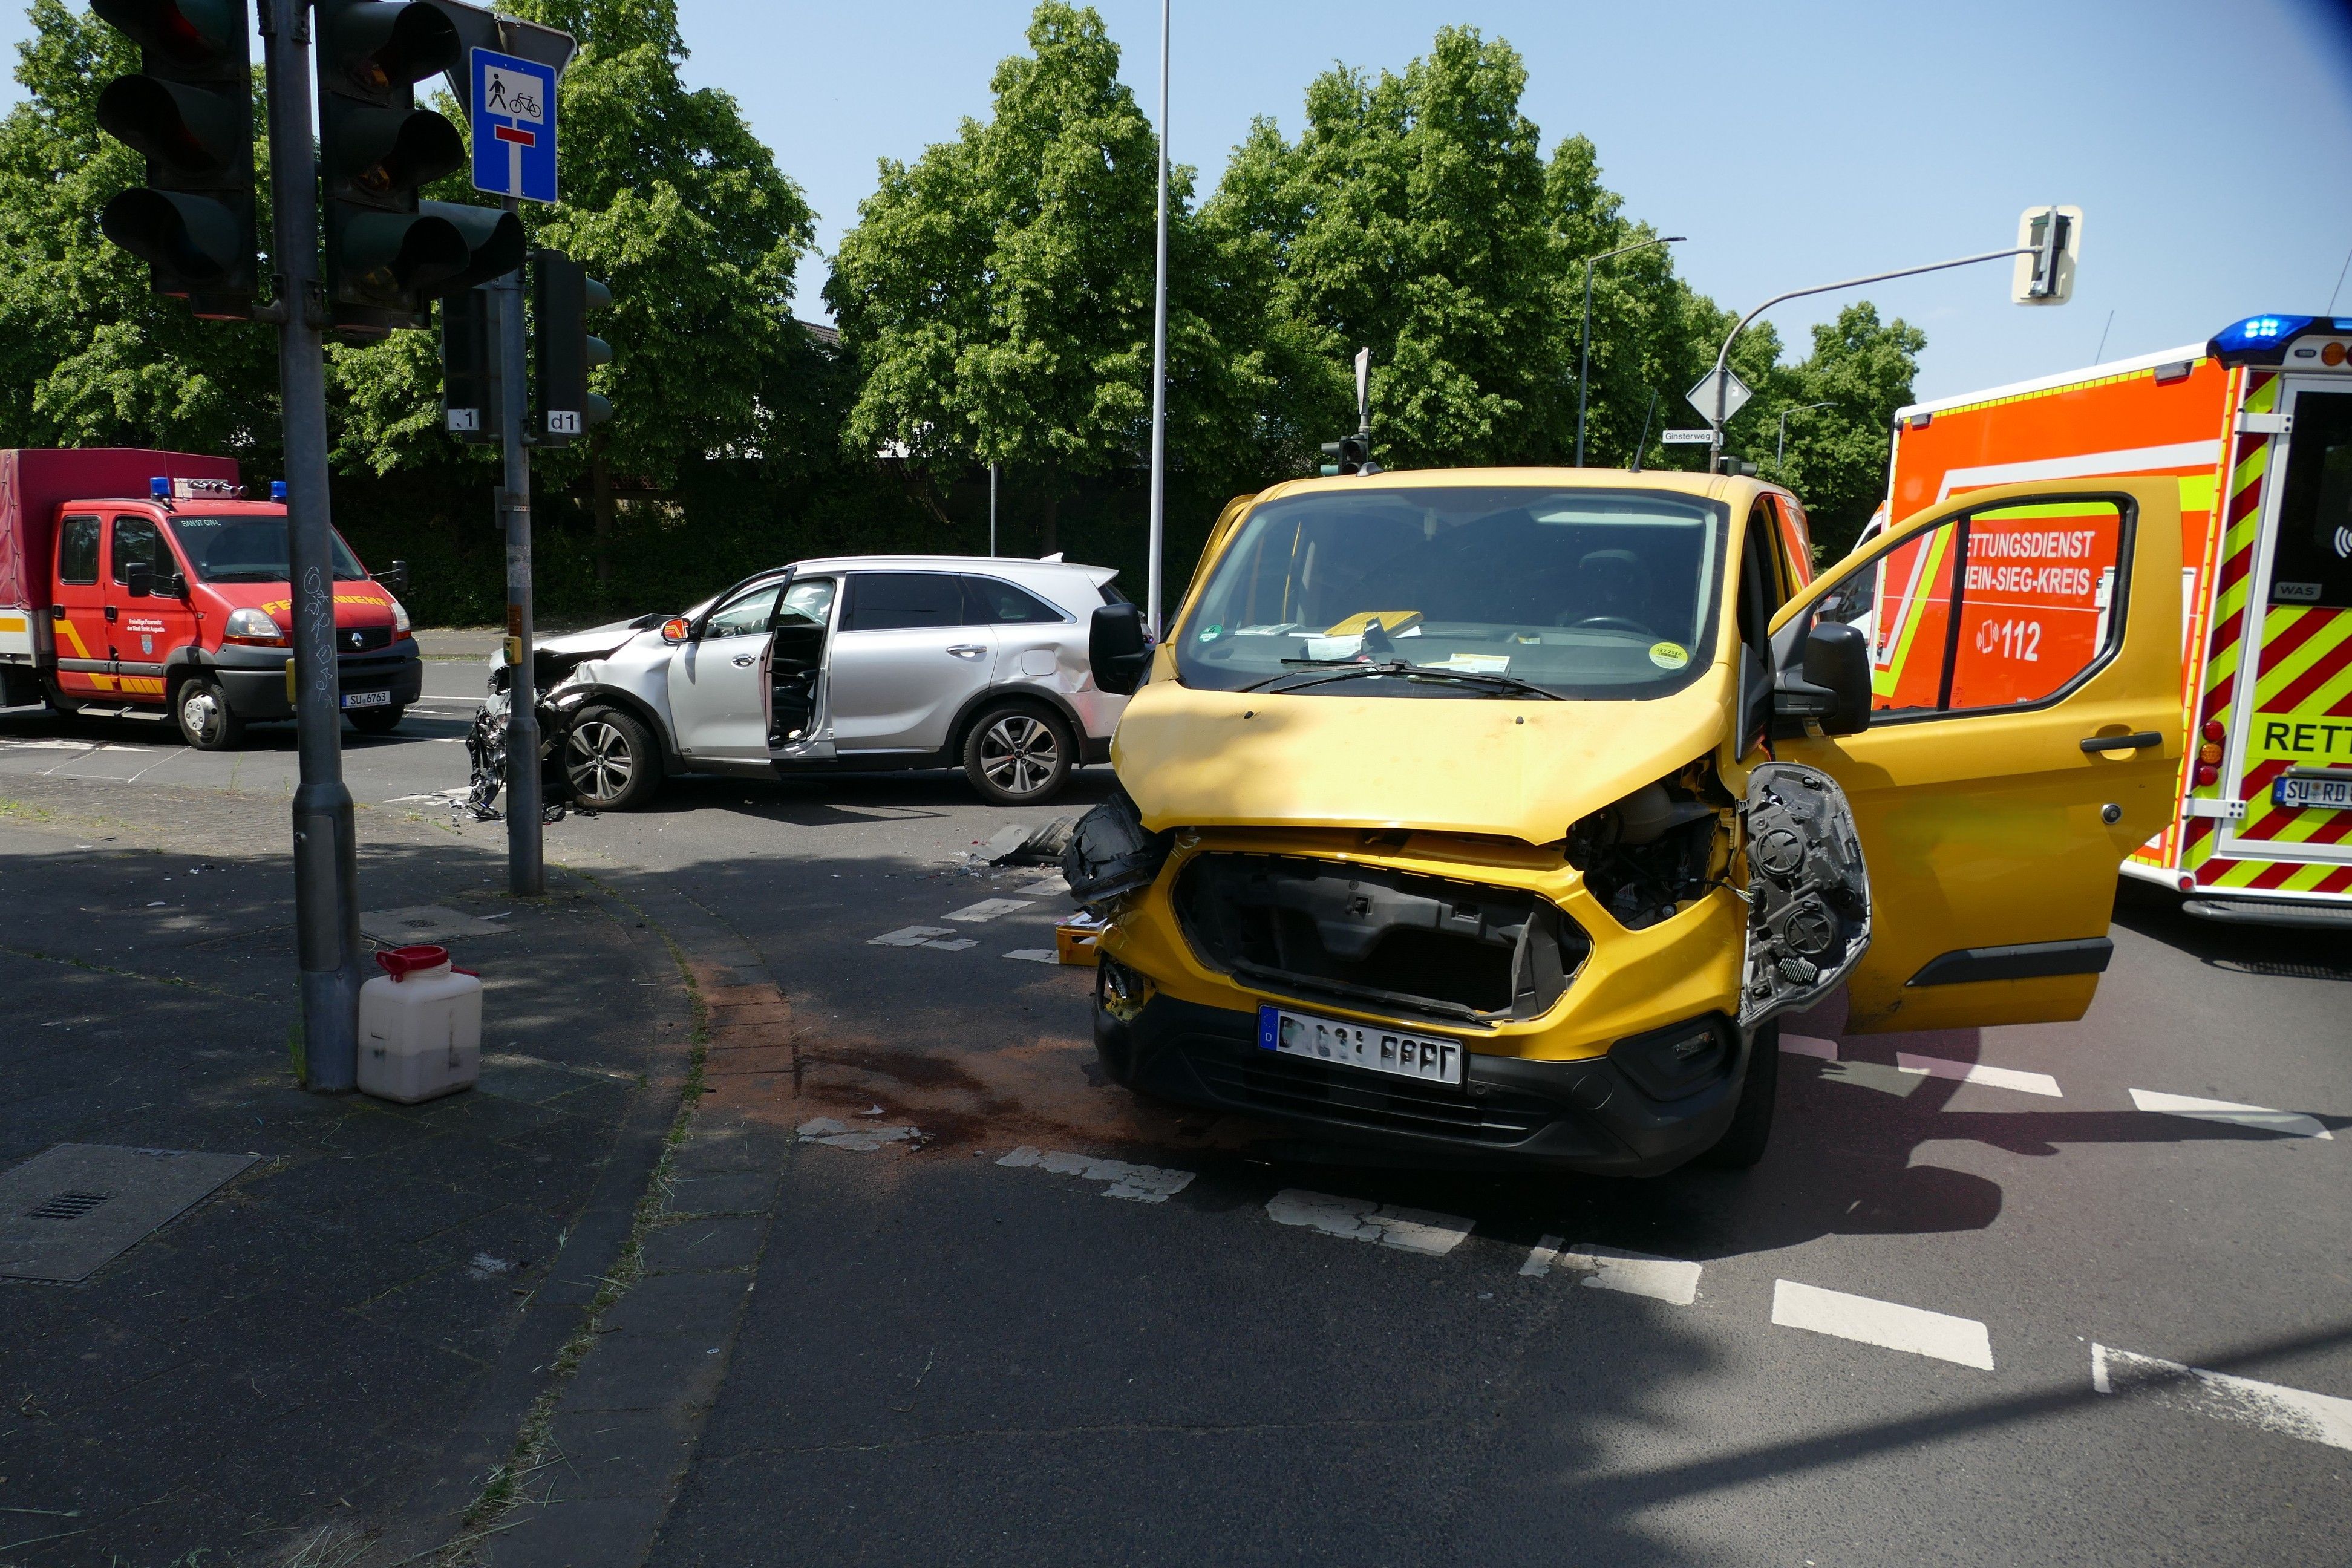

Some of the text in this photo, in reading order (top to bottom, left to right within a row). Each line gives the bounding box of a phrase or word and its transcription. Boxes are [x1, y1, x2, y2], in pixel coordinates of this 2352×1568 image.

[551, 414, 574, 430] d1
[2281, 581, 2314, 596] WAS
[2002, 619, 2040, 661] 112
[351, 696, 362, 705] SU
[367, 692, 386, 703] 6763
[2287, 781, 2310, 800] SU
[2323, 783, 2346, 802] RD
[1265, 1032, 1272, 1042] D
